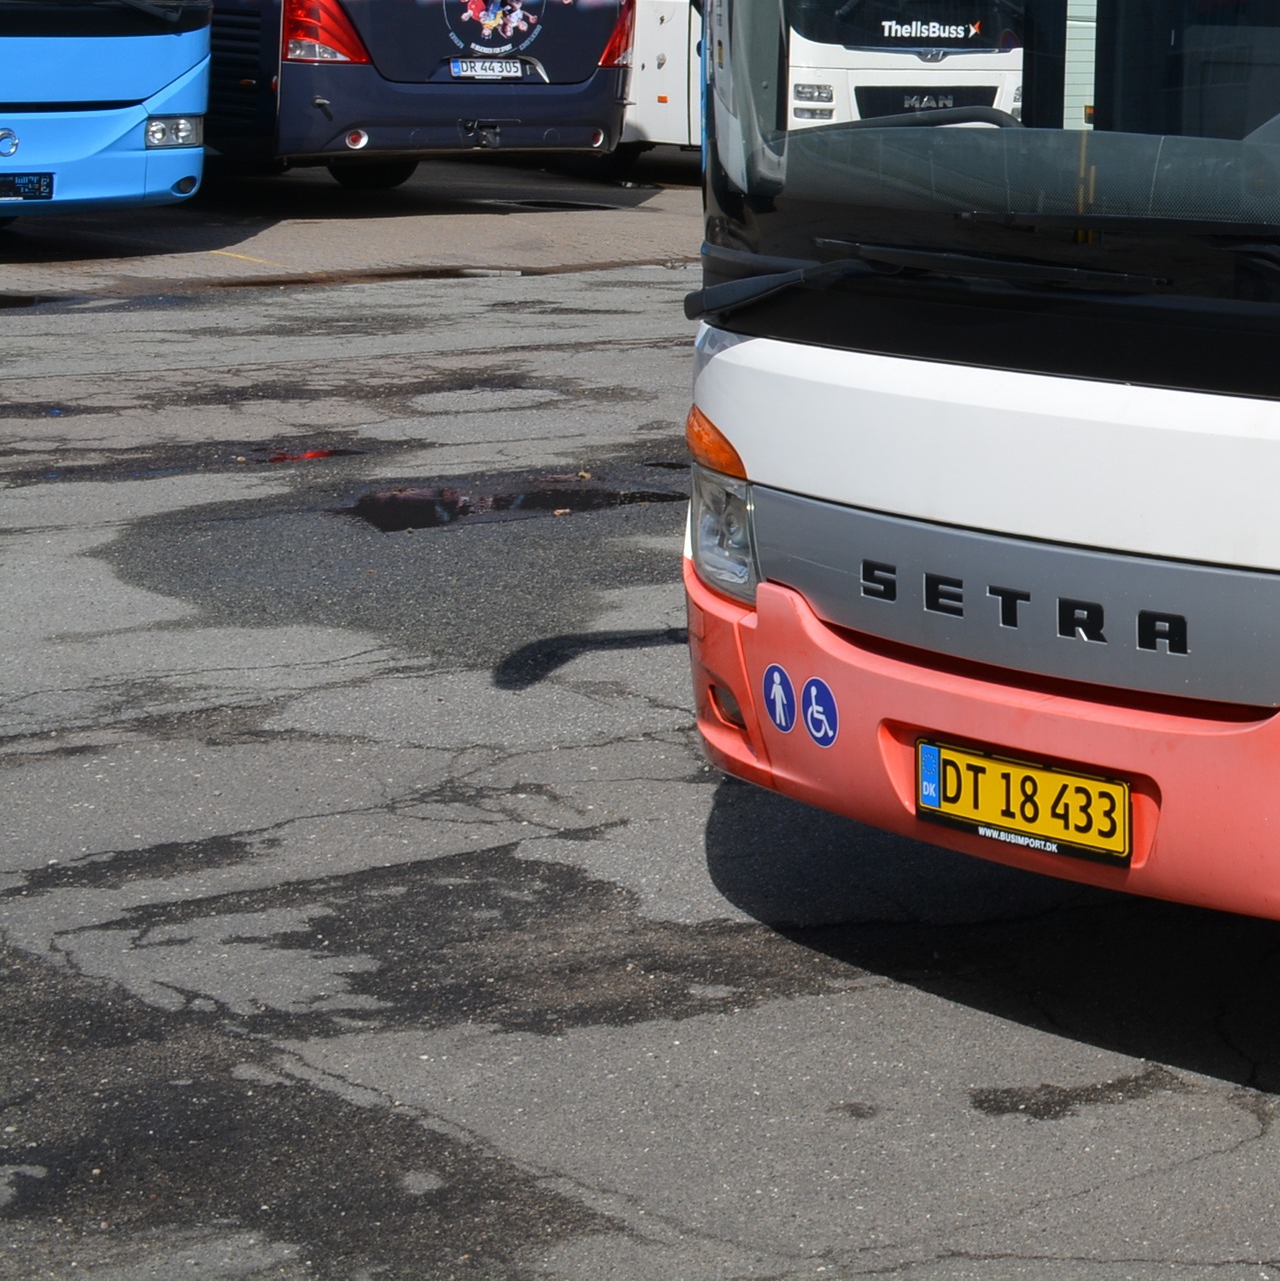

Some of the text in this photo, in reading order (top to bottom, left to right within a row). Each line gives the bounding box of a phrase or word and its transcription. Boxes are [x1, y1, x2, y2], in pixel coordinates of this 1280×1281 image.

[881, 21, 965, 38] ThellsBuss
[460, 60, 479, 73] DR
[480, 60, 495, 73] 44
[498, 61, 519, 73] 305
[904, 95, 953, 107] MAN
[860, 558, 1189, 656] SETRA
[923, 781, 936, 797] DK
[942, 758, 1117, 838] DT 18 433
[978, 826, 1058, 853] WWW.BUSIMPORT.DK
